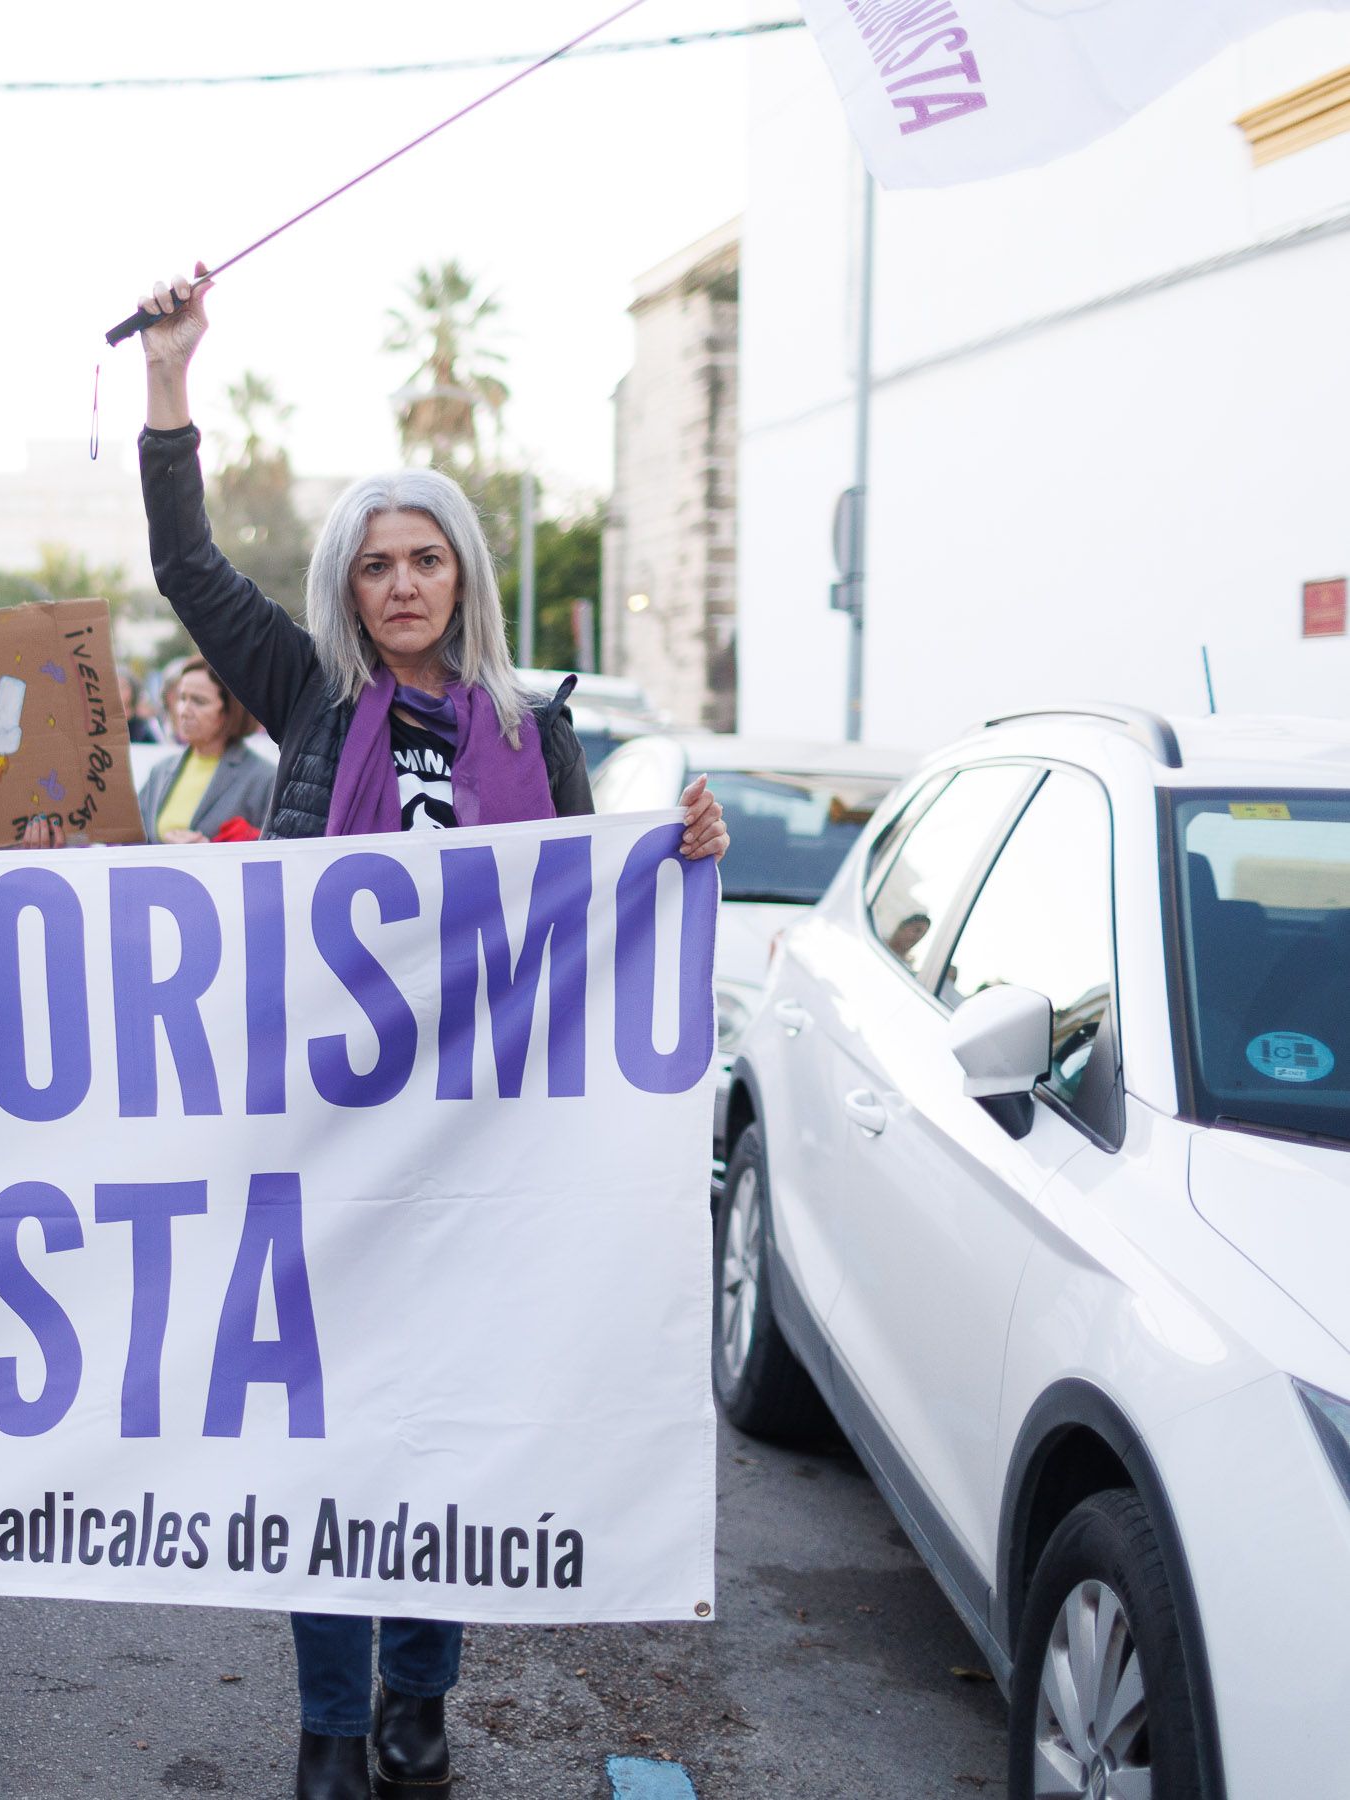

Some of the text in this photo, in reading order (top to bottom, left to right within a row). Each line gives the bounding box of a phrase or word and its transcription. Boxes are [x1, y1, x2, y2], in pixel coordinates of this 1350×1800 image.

[86, 743, 113, 793] POR
[68, 793, 98, 831] LAS
[227, 1494, 289, 1574] de
[307, 1497, 584, 1590] Andalucía
